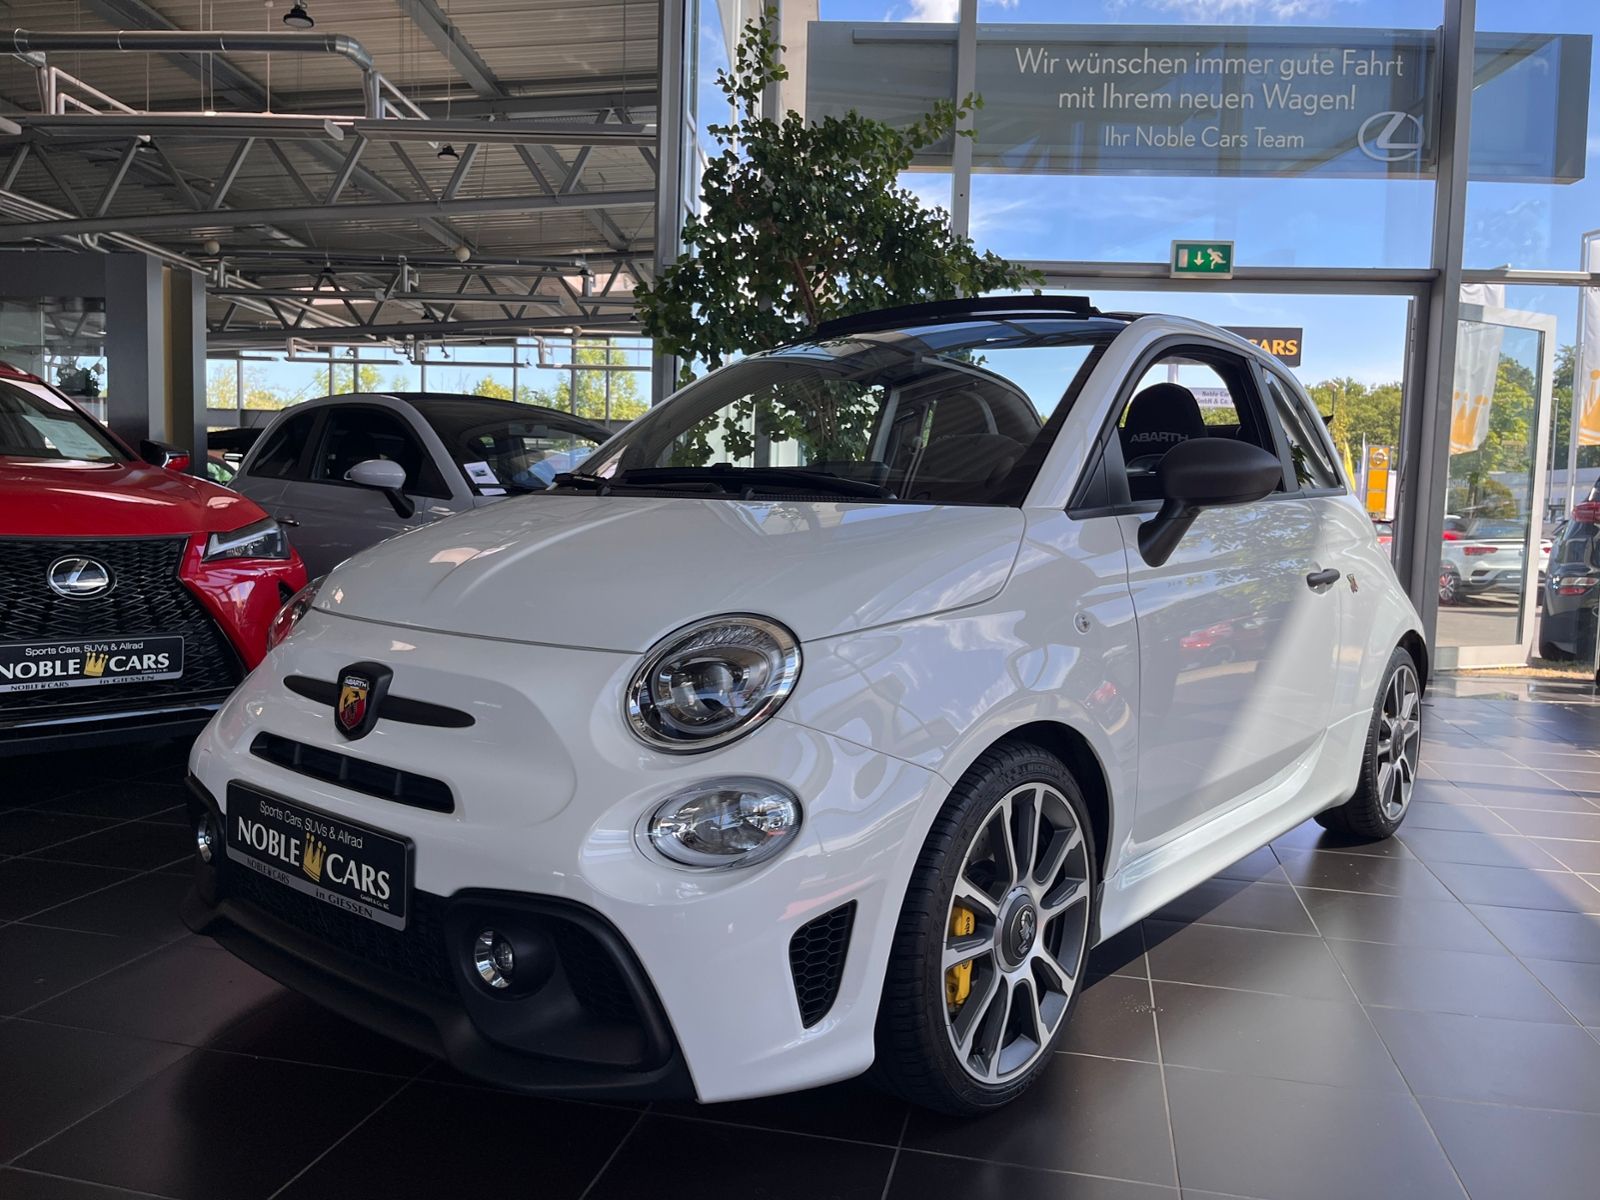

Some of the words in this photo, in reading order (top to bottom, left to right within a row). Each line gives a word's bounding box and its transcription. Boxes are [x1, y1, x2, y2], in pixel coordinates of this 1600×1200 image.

[1015, 47, 1059, 74] Wir
[1066, 47, 1187, 74] wünschen
[1195, 51, 1274, 75] immer
[1279, 52, 1334, 81] gute
[1342, 49, 1404, 77] Fahrt
[1058, 86, 1095, 109] mit
[1102, 82, 1171, 109] Ihrem
[1179, 92, 1254, 109] neuen
[1262, 83, 1356, 116] Wagen!
[1105, 125, 1130, 147] Ihr
[1135, 125, 1196, 147] Noble
[1201, 126, 1248, 148] Cars
[1254, 126, 1305, 148] Team
[1130, 431, 1189, 442] ABARTH
[25, 647, 56, 657] Sports
[58, 645, 82, 654] Cars,
[84, 644, 109, 653] SUVs
[110, 643, 118, 651] &
[119, 641, 144, 650] Allrad
[0, 658, 81, 680] NOBLE
[109, 653, 170, 672] CARS
[259, 801, 283, 819] Sports
[284, 811, 304, 831] Cars,
[304, 817, 328, 837] SUVs
[328, 826, 336, 839] &
[338, 829, 363, 849] Allrad
[238, 815, 300, 867] NOBLE
[326, 853, 391, 900] CARS
[315, 887, 325, 899] in
[327, 889, 373, 919] GIESSEN
